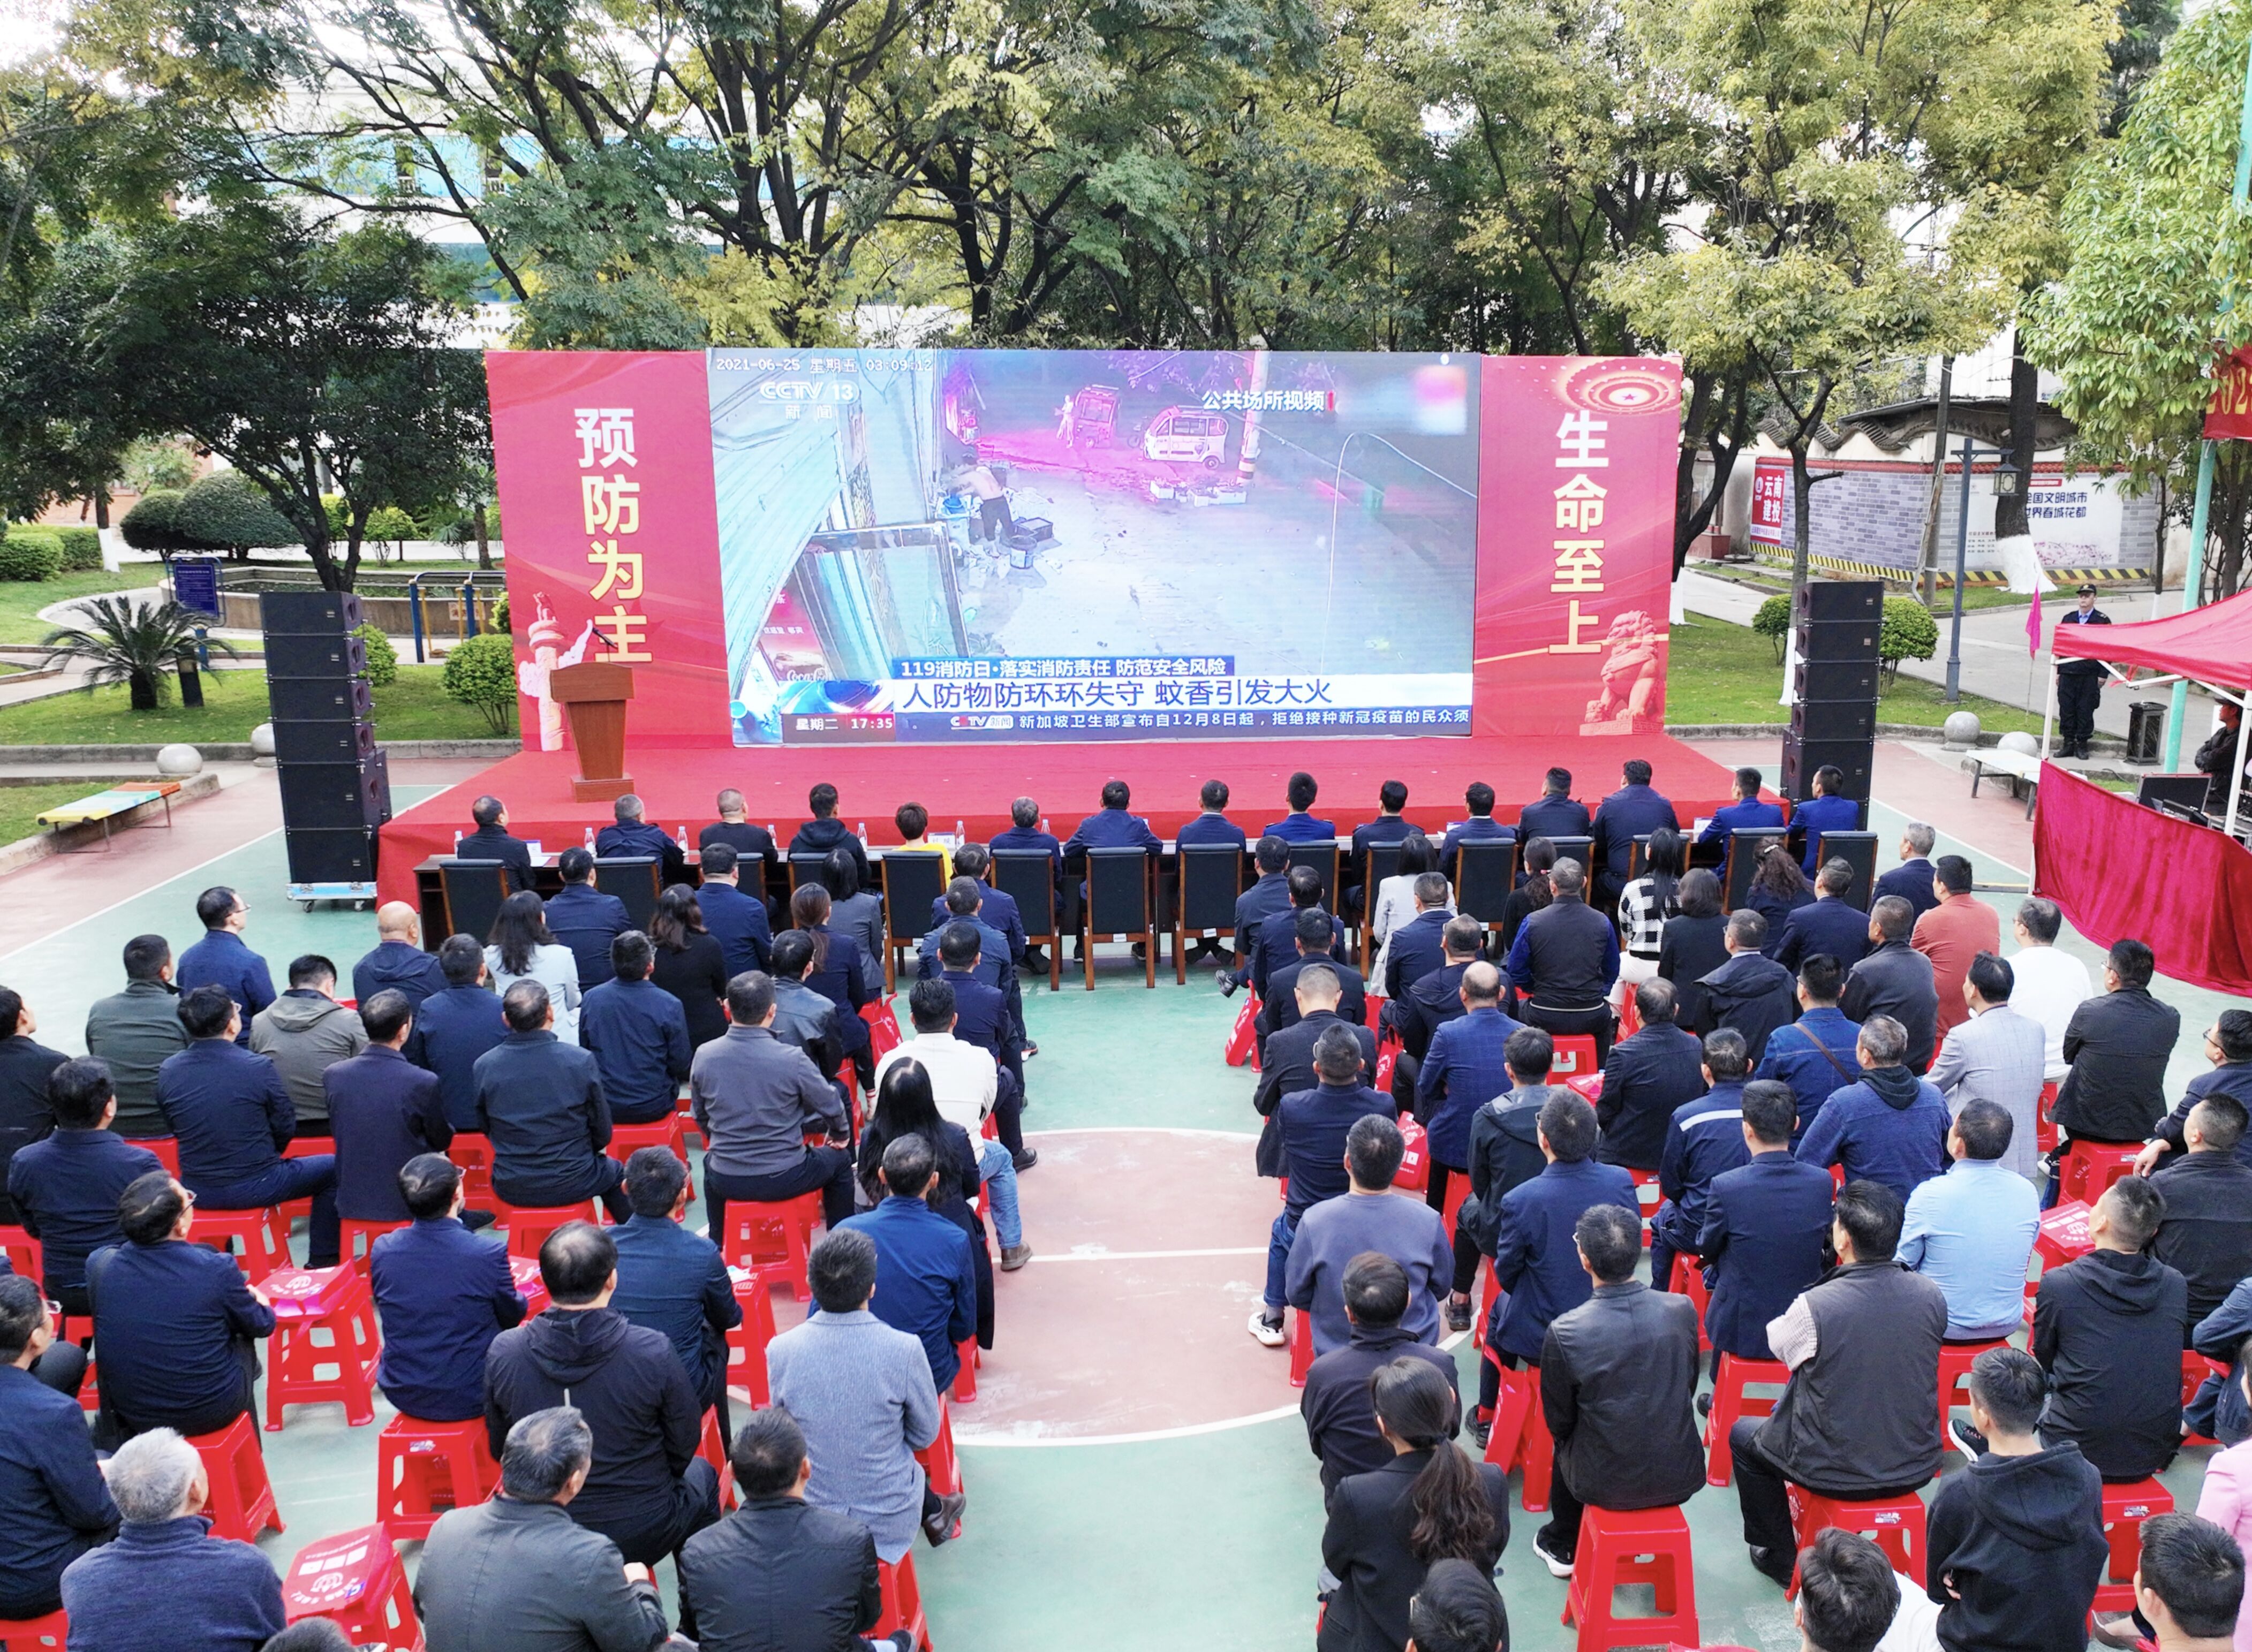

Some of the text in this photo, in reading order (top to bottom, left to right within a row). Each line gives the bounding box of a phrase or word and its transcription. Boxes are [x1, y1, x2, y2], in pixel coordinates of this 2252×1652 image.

[716, 358, 801, 371] 2021-06-25
[810, 358, 859, 374] 星期五
[760, 381, 855, 401] CCTV 13
[1201, 390, 1325, 411] 公共场所视频
[1764, 475, 1784, 499] 云南
[573, 407, 653, 664] 预防为主
[1547, 409, 1609, 654] 生命至上
[901, 658, 1227, 678] 119消防日·落实消防责任 防范安全风险
[902, 678, 1333, 709] 人防物防环环失守 蚊香引发大火
[796, 717, 894, 731] 星期二 17:35
